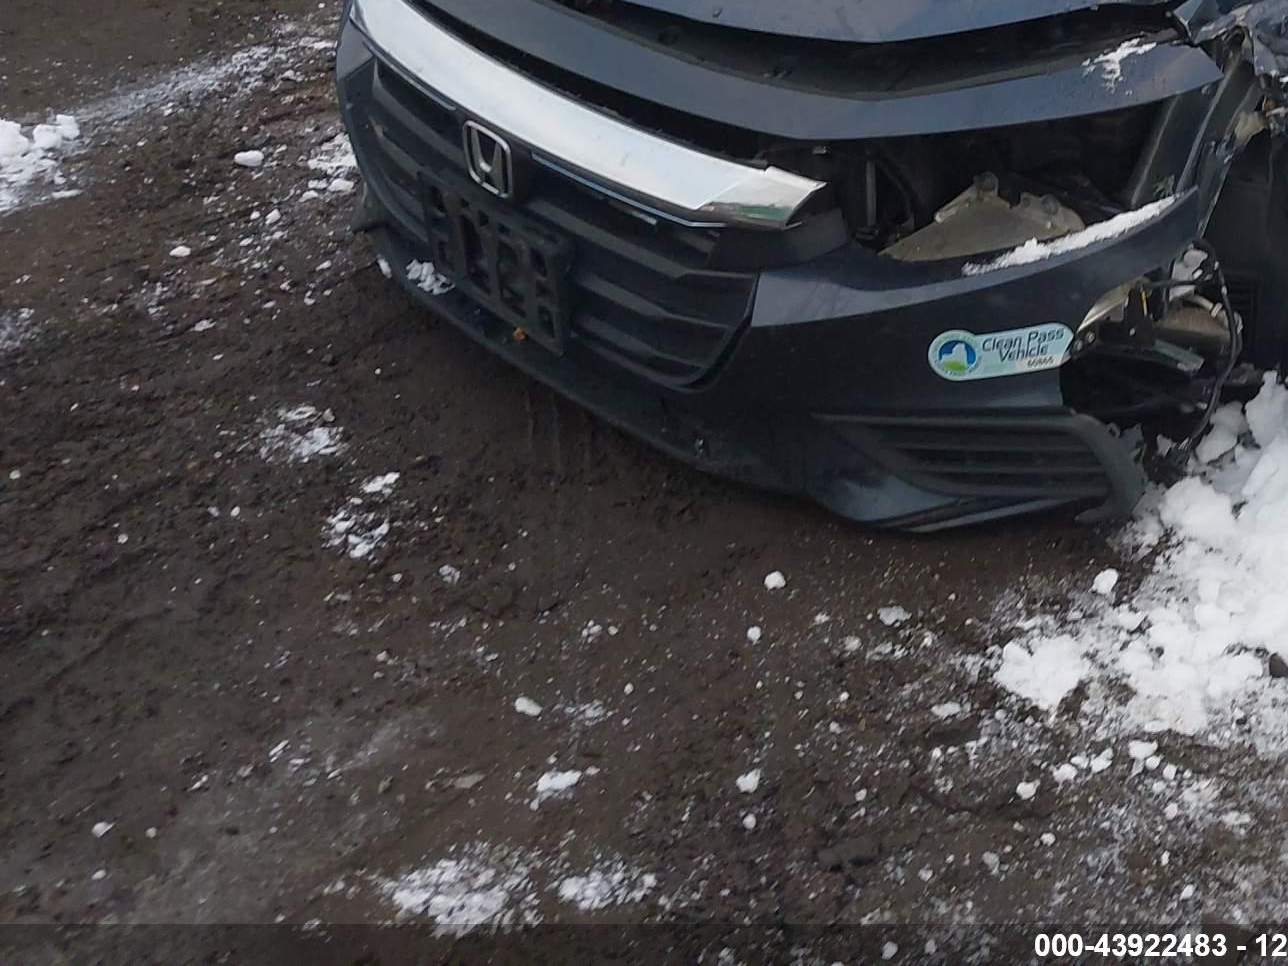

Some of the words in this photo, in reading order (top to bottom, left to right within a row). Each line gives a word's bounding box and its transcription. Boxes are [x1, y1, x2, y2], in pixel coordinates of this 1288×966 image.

[982, 336, 1023, 352] Clean
[1027, 327, 1065, 343] Pass
[1000, 343, 1049, 362] Vehicle
